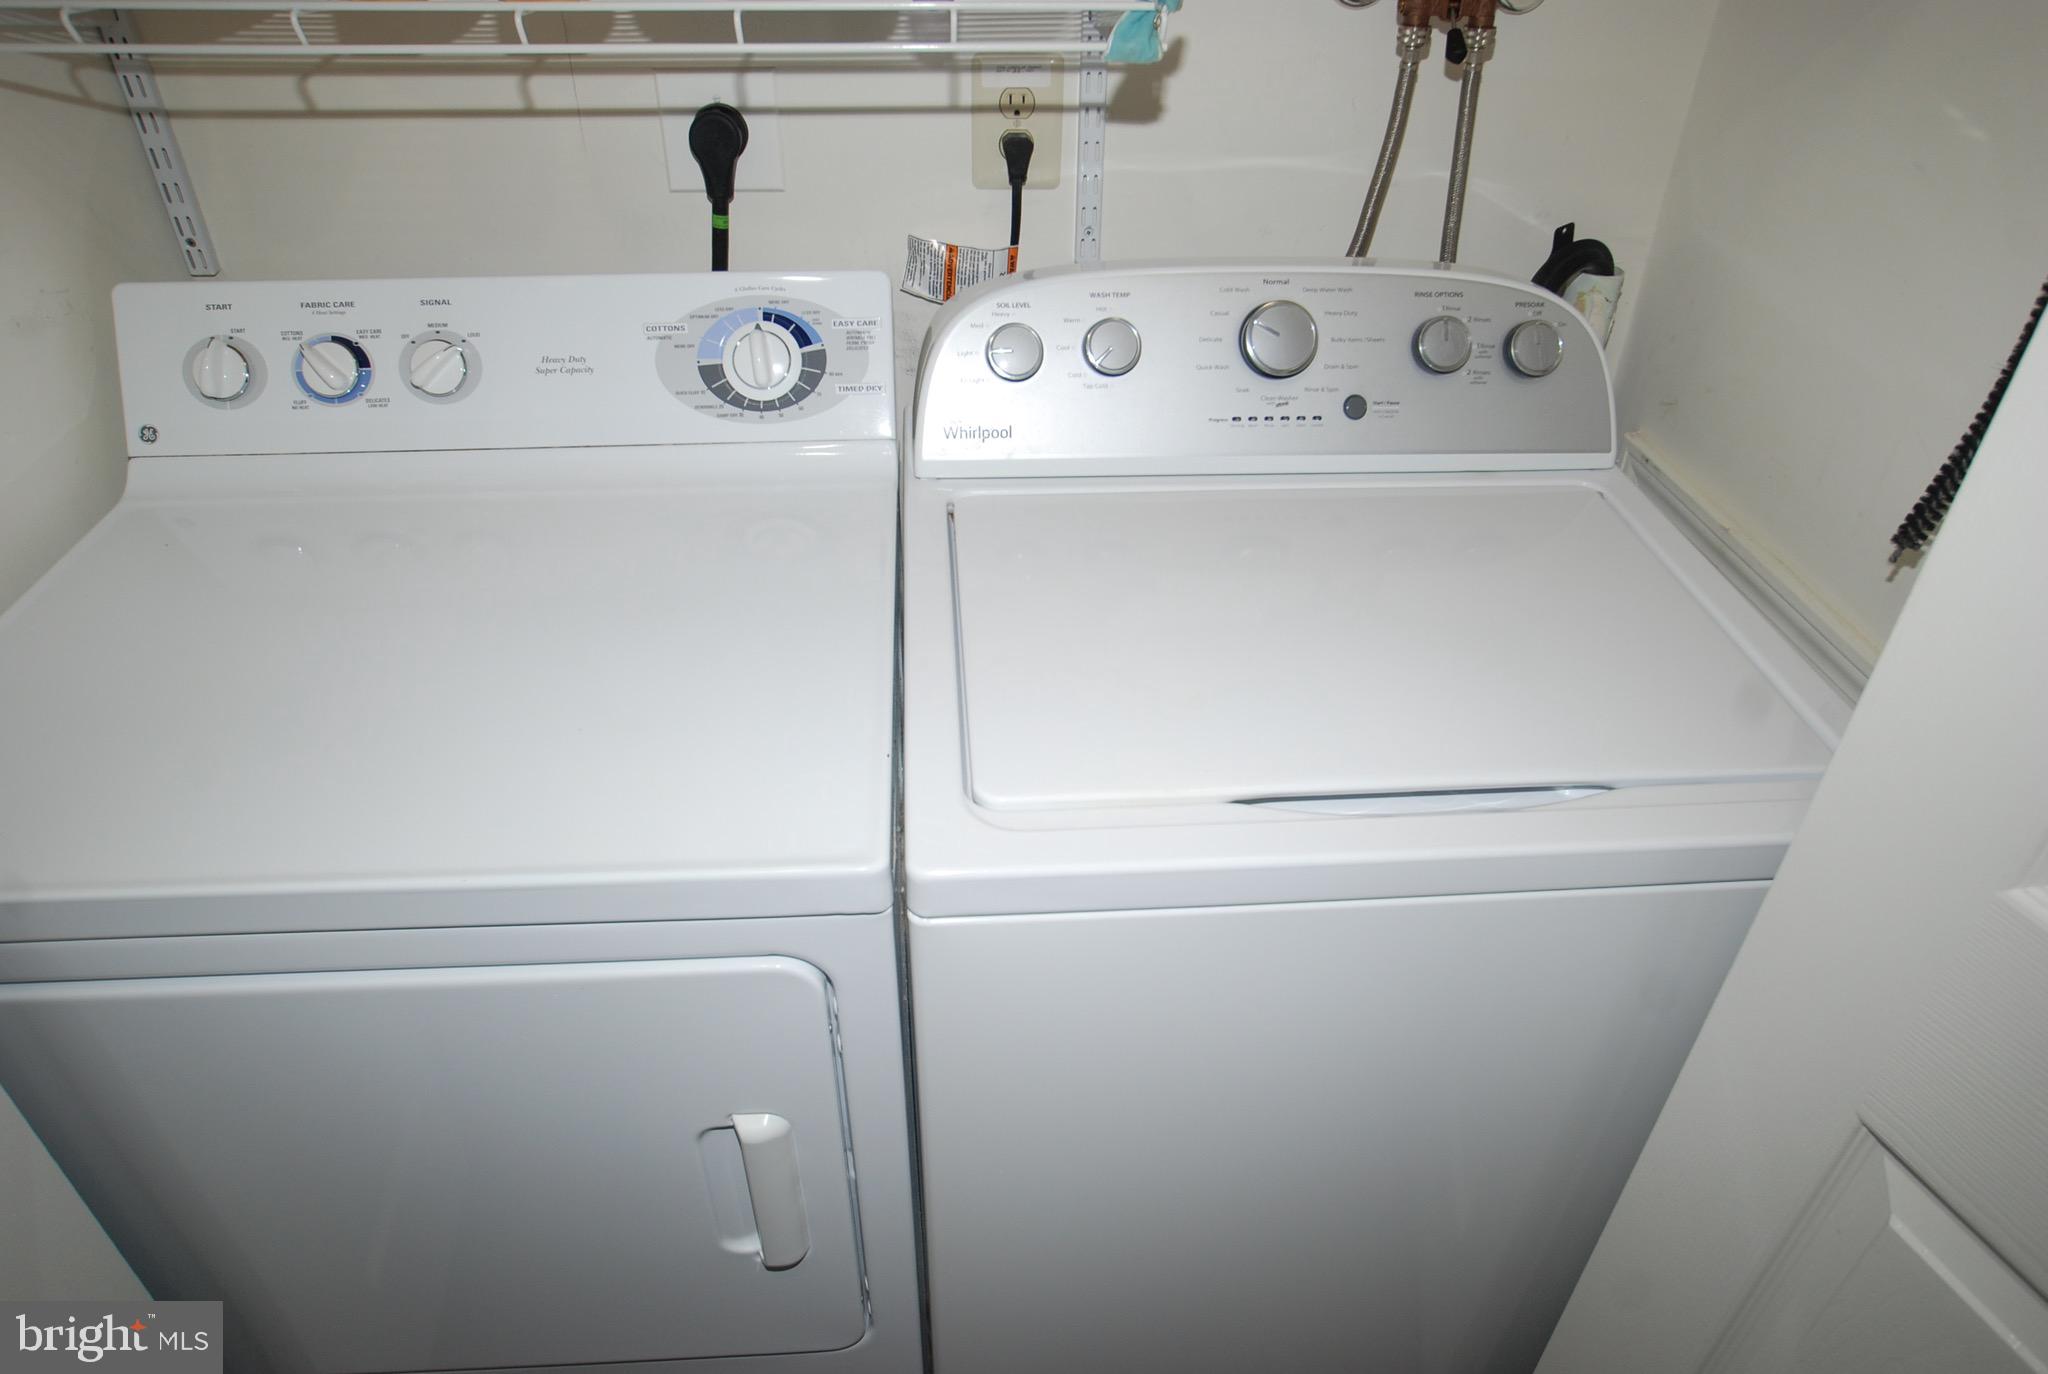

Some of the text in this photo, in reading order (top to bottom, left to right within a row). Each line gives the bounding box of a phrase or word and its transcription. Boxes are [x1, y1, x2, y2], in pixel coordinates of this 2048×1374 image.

[542, 355, 586, 365] Heavy Duty
[536, 366, 594, 376] Super Capacity
[944, 424, 1012, 443] Whirlpool
